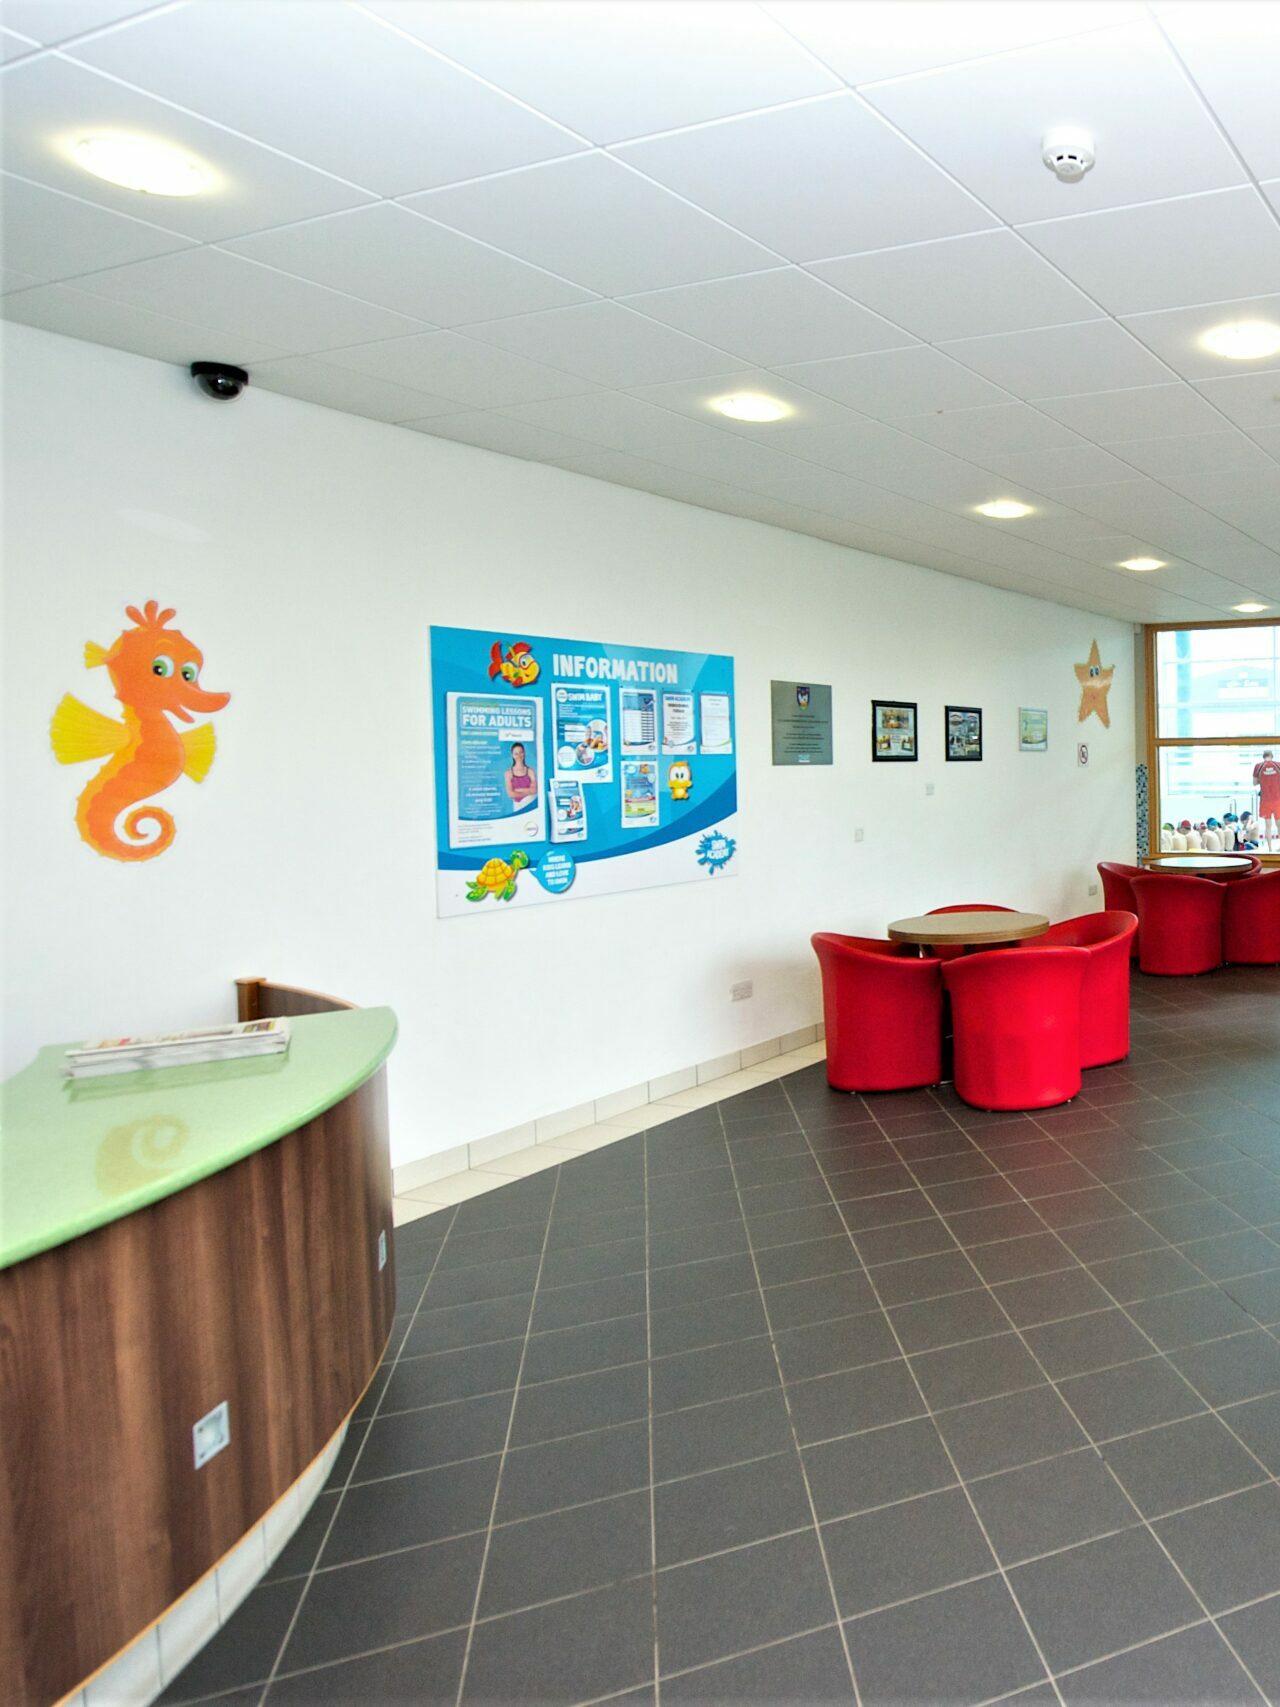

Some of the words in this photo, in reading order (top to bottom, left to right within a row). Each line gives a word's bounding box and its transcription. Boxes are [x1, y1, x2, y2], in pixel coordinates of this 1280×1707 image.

[552, 653, 678, 684] INFORMATION
[501, 707, 532, 716] LESSONS
[462, 714, 487, 727] FOR
[489, 715, 532, 728] ADULTS
